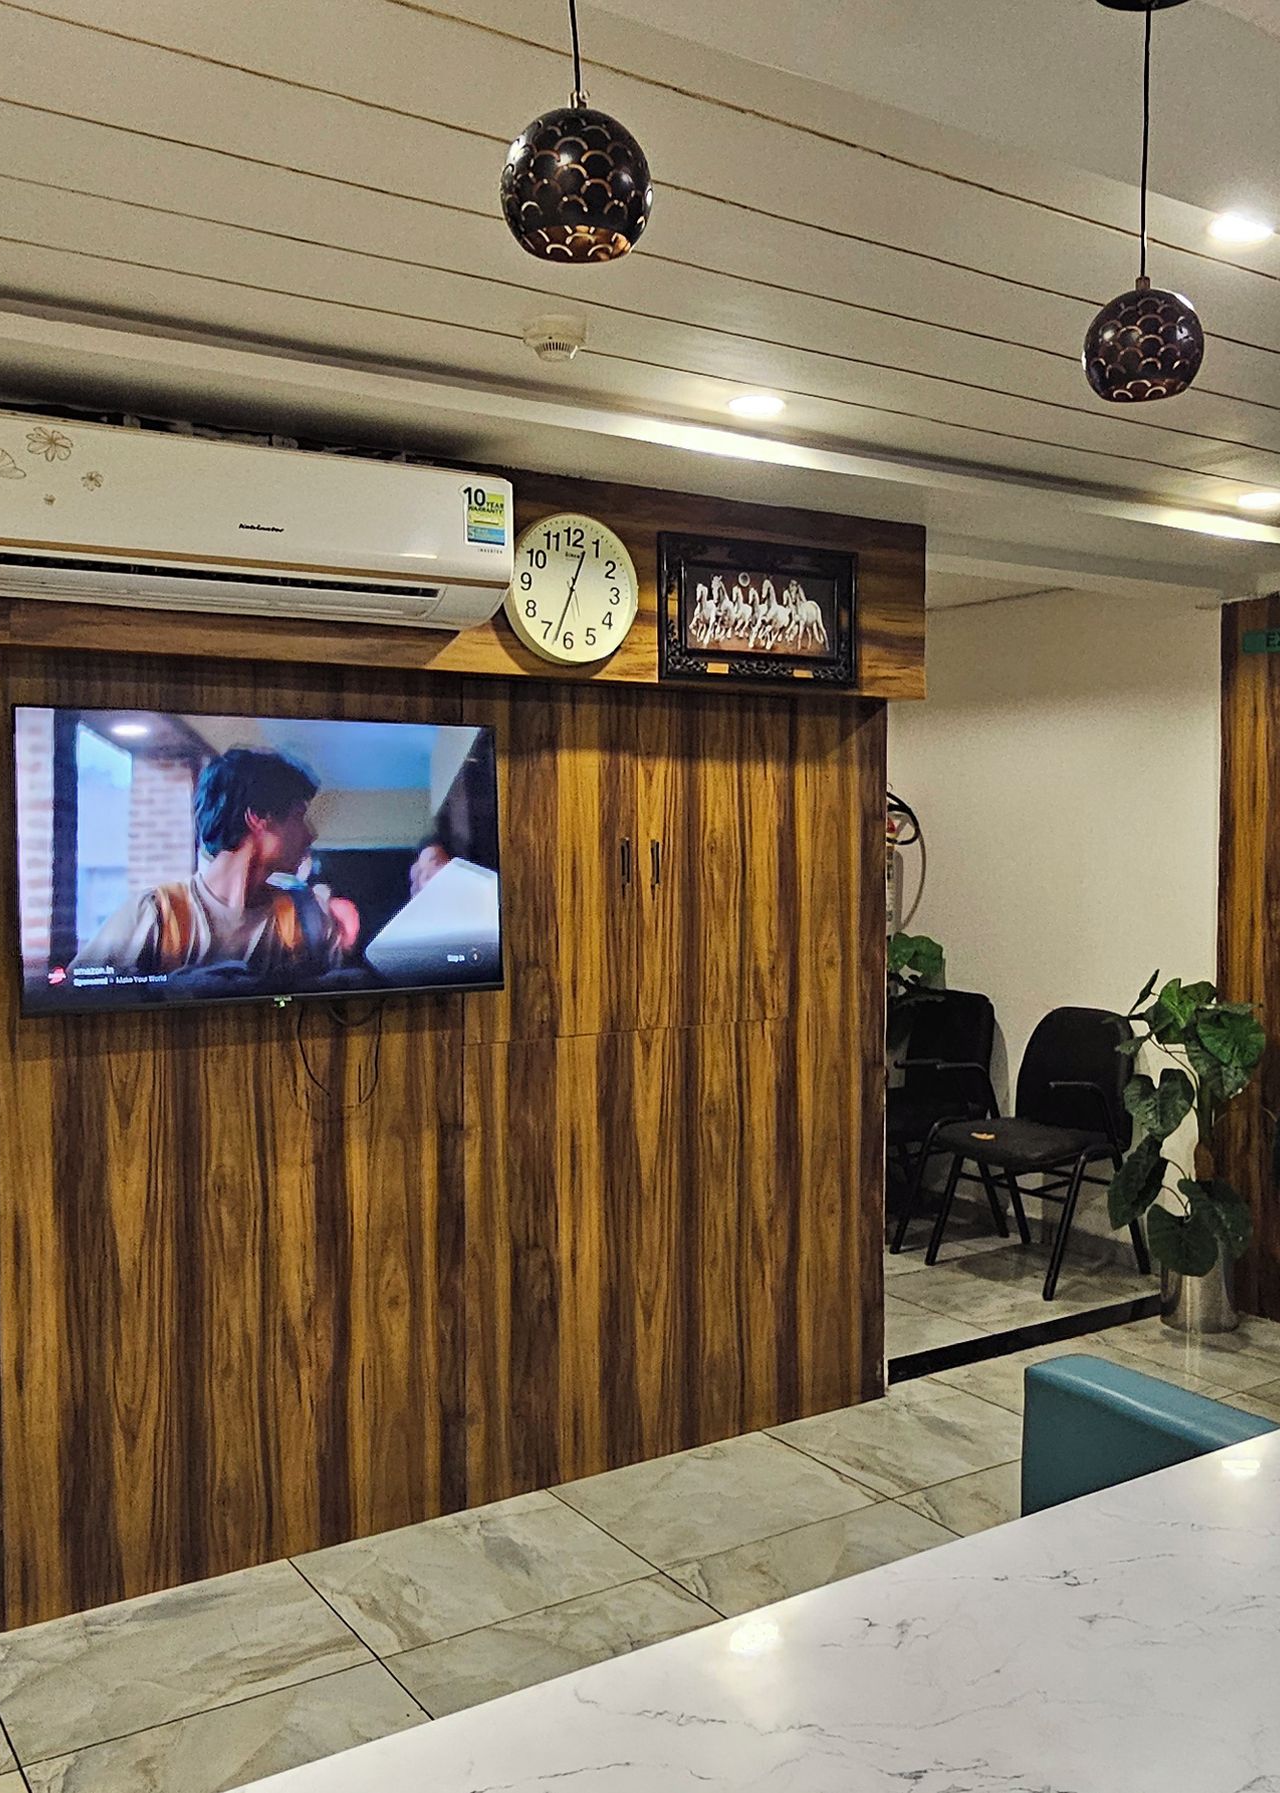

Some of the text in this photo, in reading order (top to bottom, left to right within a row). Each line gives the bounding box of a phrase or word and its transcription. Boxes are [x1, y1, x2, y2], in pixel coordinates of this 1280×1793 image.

[463, 487, 486, 506] 10
[543, 530, 560, 551] 11
[564, 527, 584, 549] 12
[592, 539, 600, 558] 1
[527, 548, 547, 569] 10
[604, 560, 616, 579] 2
[520, 572, 532, 591] 9
[609, 587, 620, 605] 3
[525, 600, 536, 618] 8
[541, 620, 552, 640] 7
[602, 612, 613, 630] 4
[563, 631, 574, 649] 6
[585, 628, 596, 645] 5
